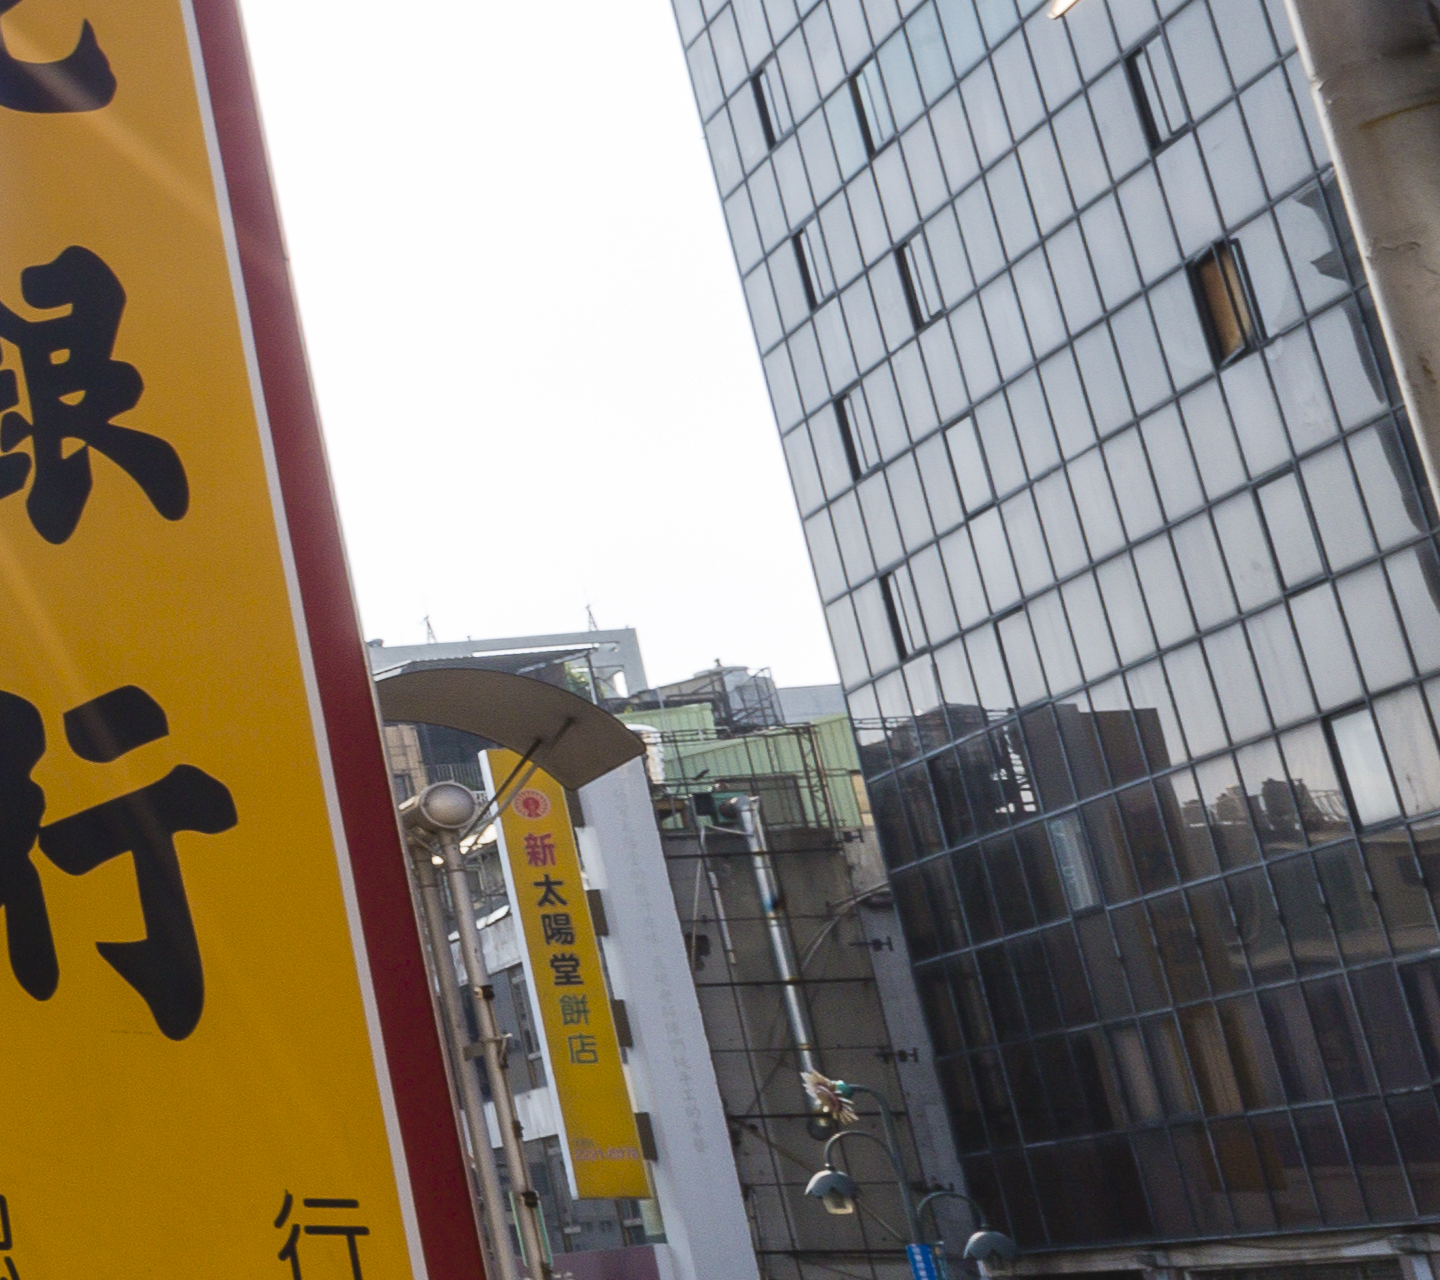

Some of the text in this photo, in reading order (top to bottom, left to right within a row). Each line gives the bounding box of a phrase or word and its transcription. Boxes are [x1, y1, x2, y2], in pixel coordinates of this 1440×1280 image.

[523, 832, 599, 1065] 新太陽堂餅店
